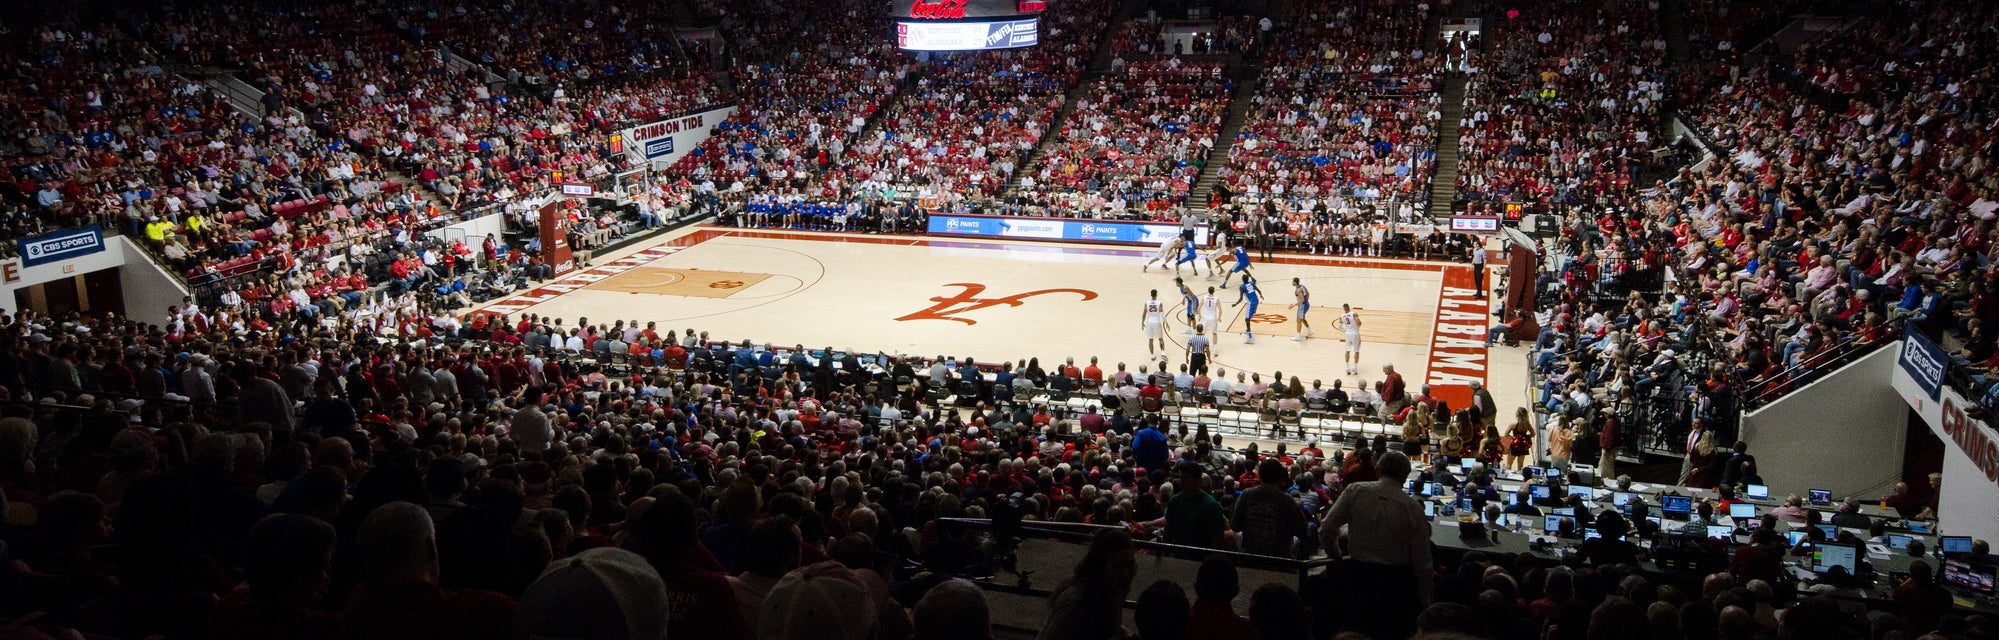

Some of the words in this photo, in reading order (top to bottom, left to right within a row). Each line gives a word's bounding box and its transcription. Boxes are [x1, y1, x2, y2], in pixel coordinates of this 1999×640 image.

[911, 0, 968, 19] Coca-Cola
[633, 121, 679, 141] CRIMSON
[682, 116, 703, 131] TIDE
[1017, 224, 1053, 232] ppgpaints.com
[1082, 224, 1094, 234] PPG
[1096, 226, 1117, 234] PAINTS
[43, 243, 60, 252] CBS
[62, 235, 93, 248] SPORTS
[2, 261, 20, 283] E
[481, 245, 690, 315] ALABAMA
[1149, 304, 1158, 313] 25
[1345, 317, 1351, 325] 3
[1428, 286, 1488, 386] ALABAMA
[1941, 397, 1999, 488] CRIMS
